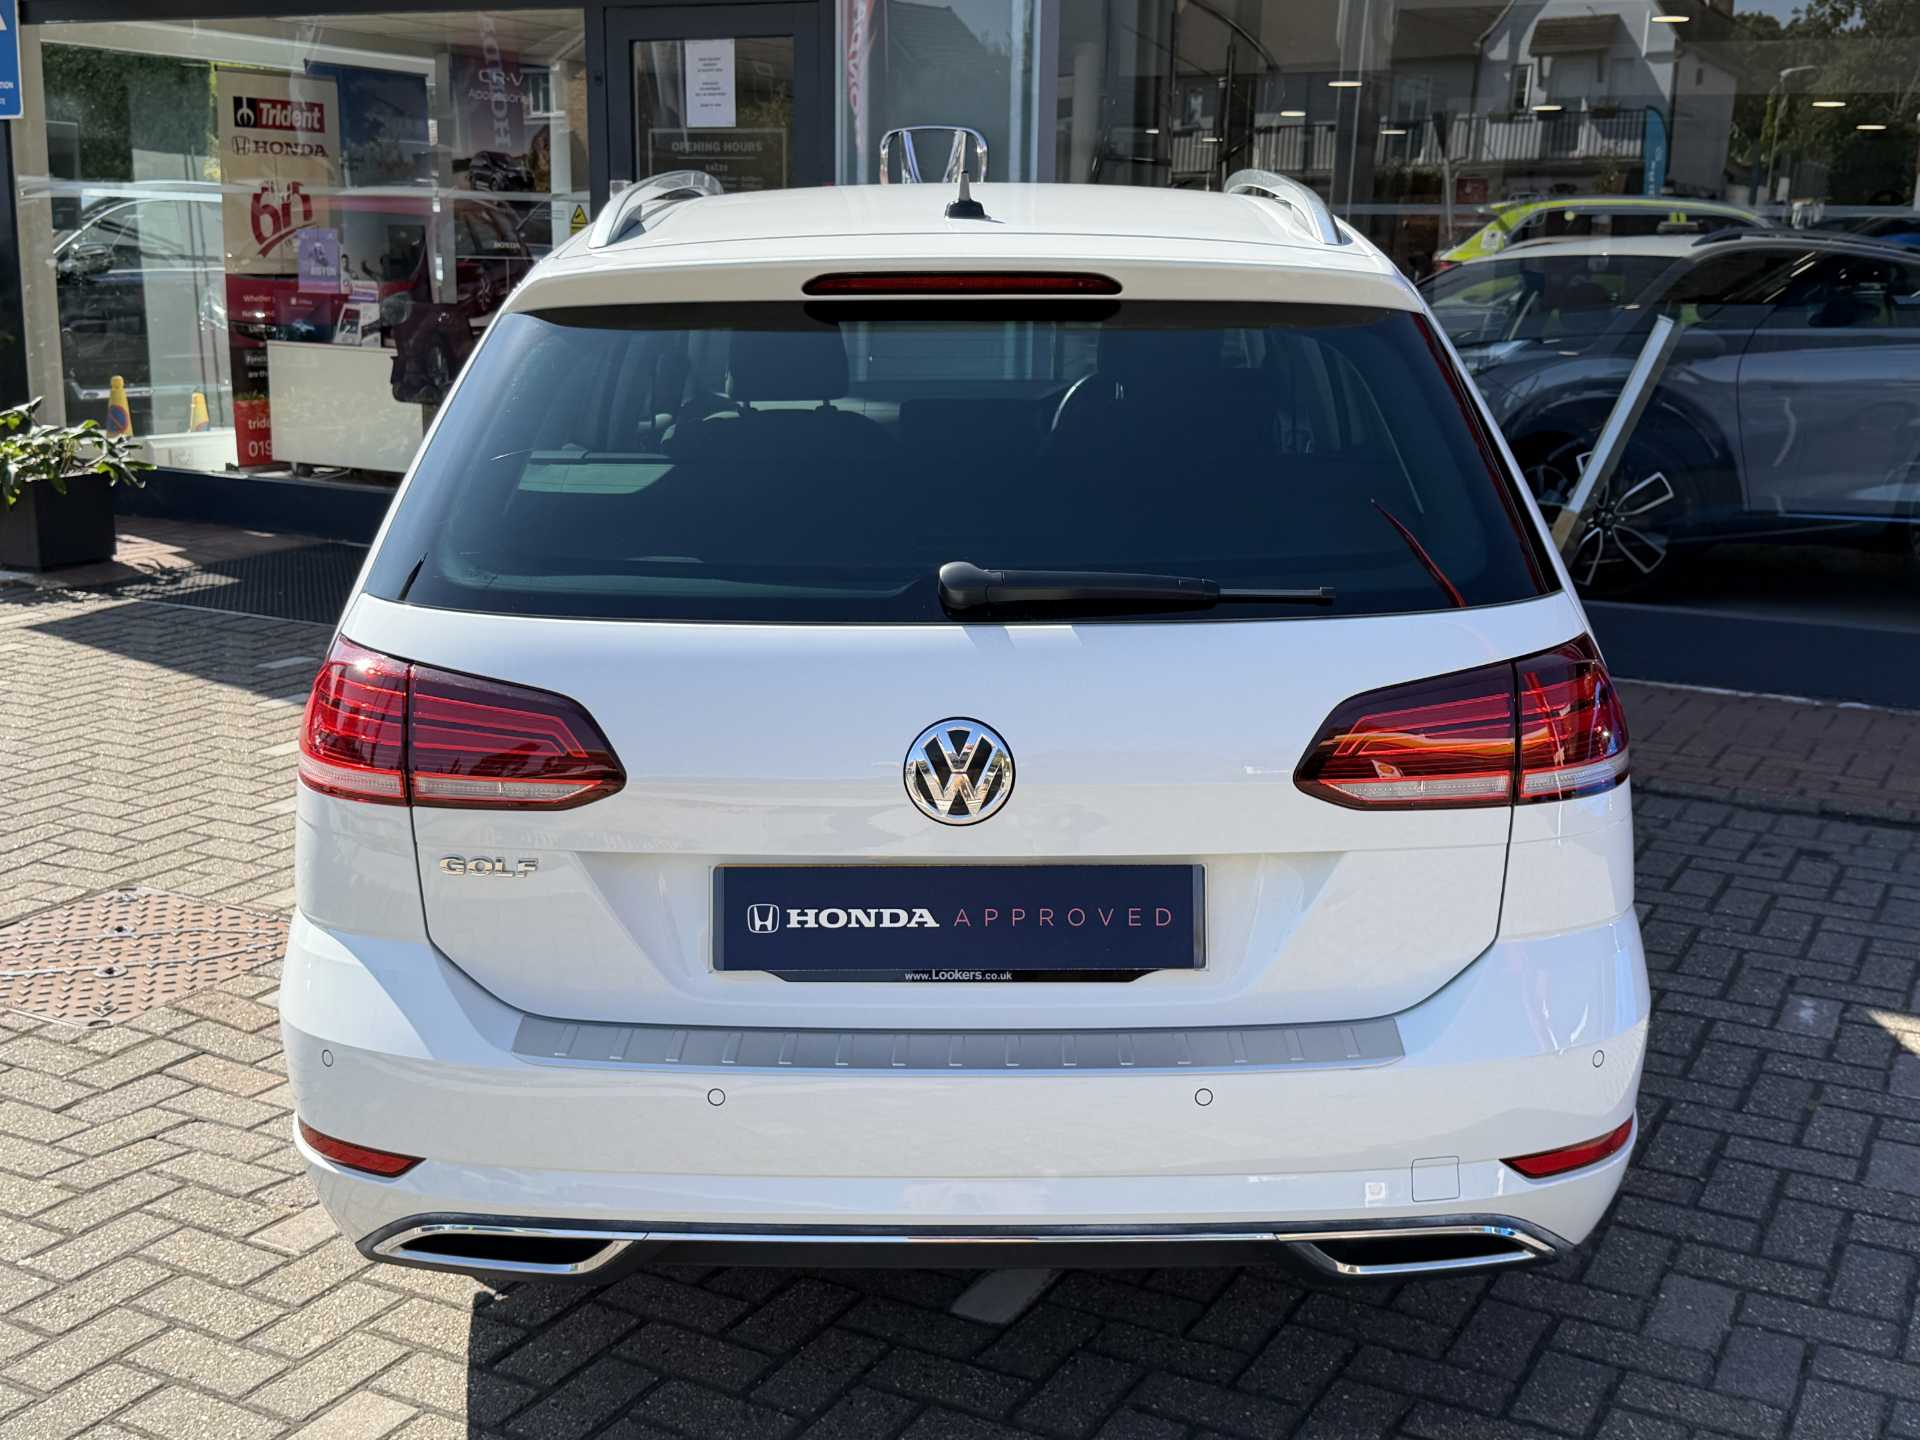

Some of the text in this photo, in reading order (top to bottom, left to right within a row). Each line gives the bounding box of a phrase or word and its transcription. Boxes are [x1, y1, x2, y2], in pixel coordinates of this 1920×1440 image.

[259, 102, 322, 130] Trident
[252, 139, 329, 158] HONDA
[672, 141, 763, 153] OPENING HOURS
[440, 857, 538, 878] GOLF
[786, 908, 940, 928] HONDA
[953, 908, 1173, 927] APPROVED
[904, 968, 1013, 981] www.Lookers.co.uk
